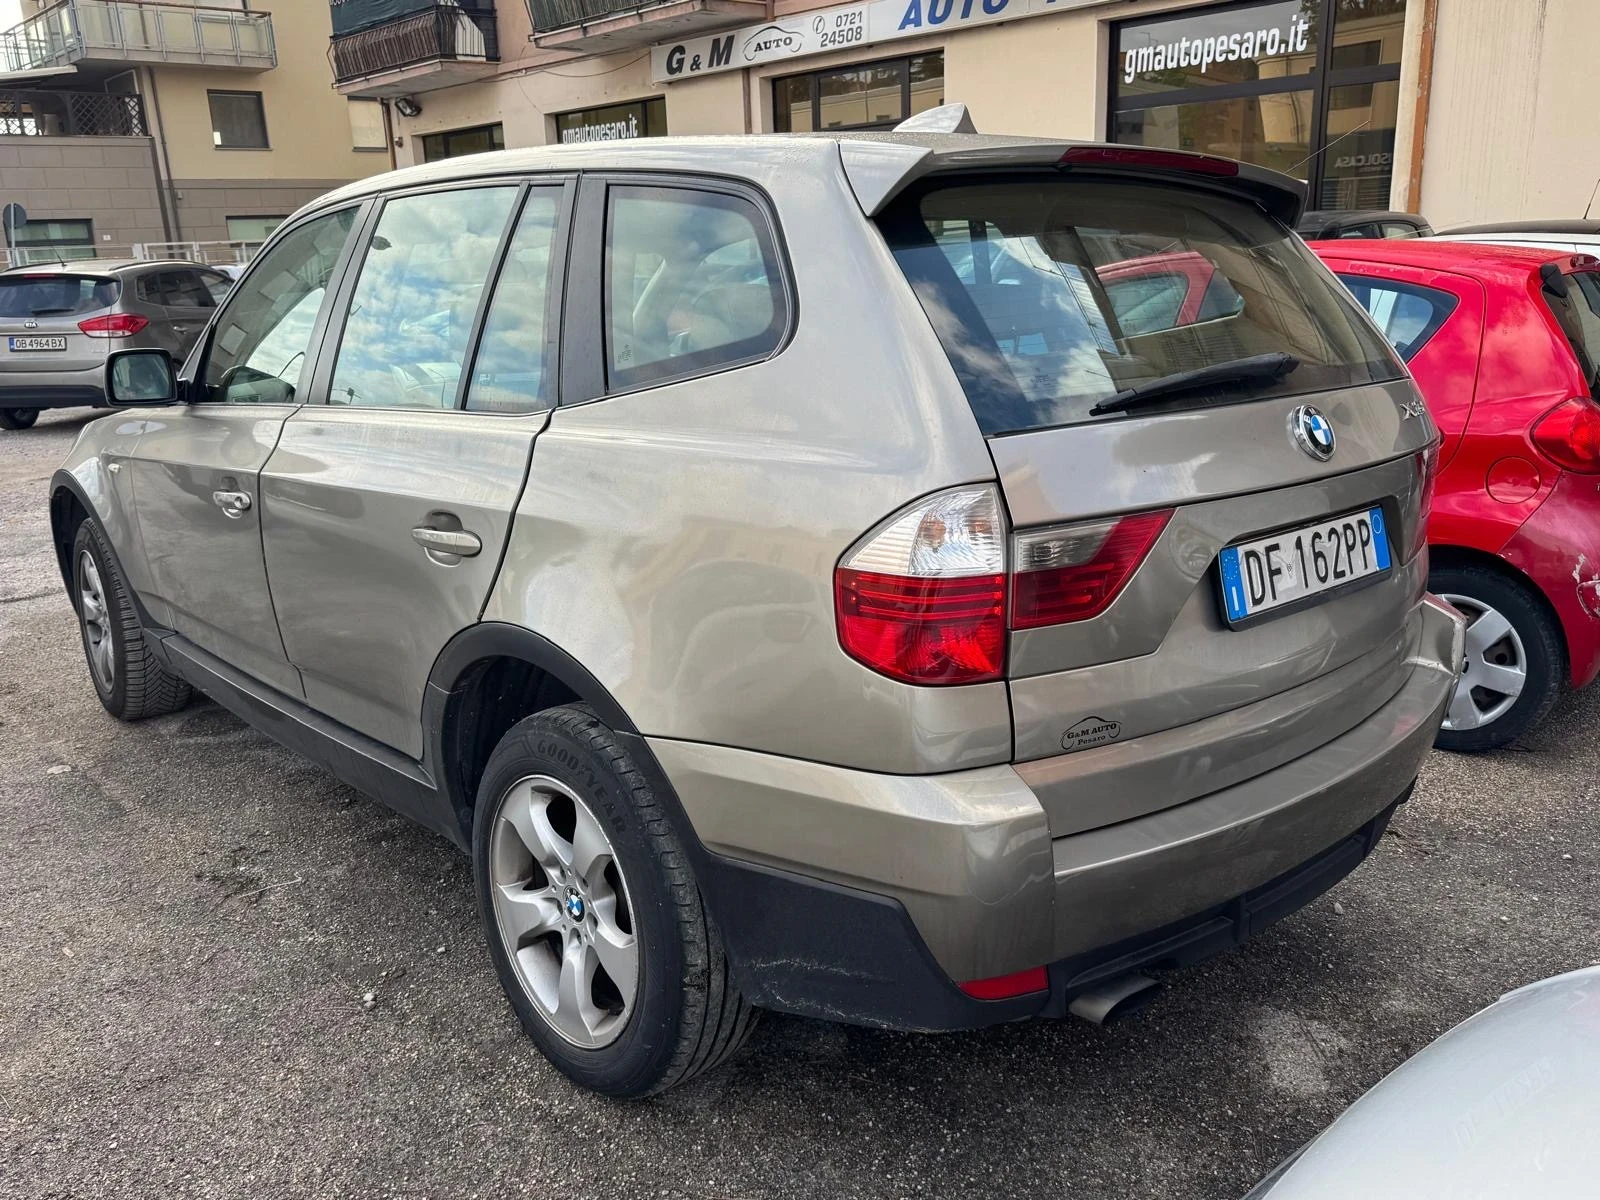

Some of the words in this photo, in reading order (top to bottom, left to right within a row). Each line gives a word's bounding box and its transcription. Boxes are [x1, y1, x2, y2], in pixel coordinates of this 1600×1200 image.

[836, 11, 862, 28] 0721
[754, 37, 793, 52] AUTO
[820, 26, 863, 48] 24508
[666, 45, 686, 75] G
[690, 54, 702, 72] &
[708, 35, 735, 68] M
[1124, 15, 1309, 84] gmautopesaro.it
[28, 339, 50, 348] 4964
[1245, 543, 1282, 607] DF
[1295, 519, 1371, 589] 162PP
[1091, 723, 1117, 735] AUTO
[1077, 735, 1106, 746] Pesaro
